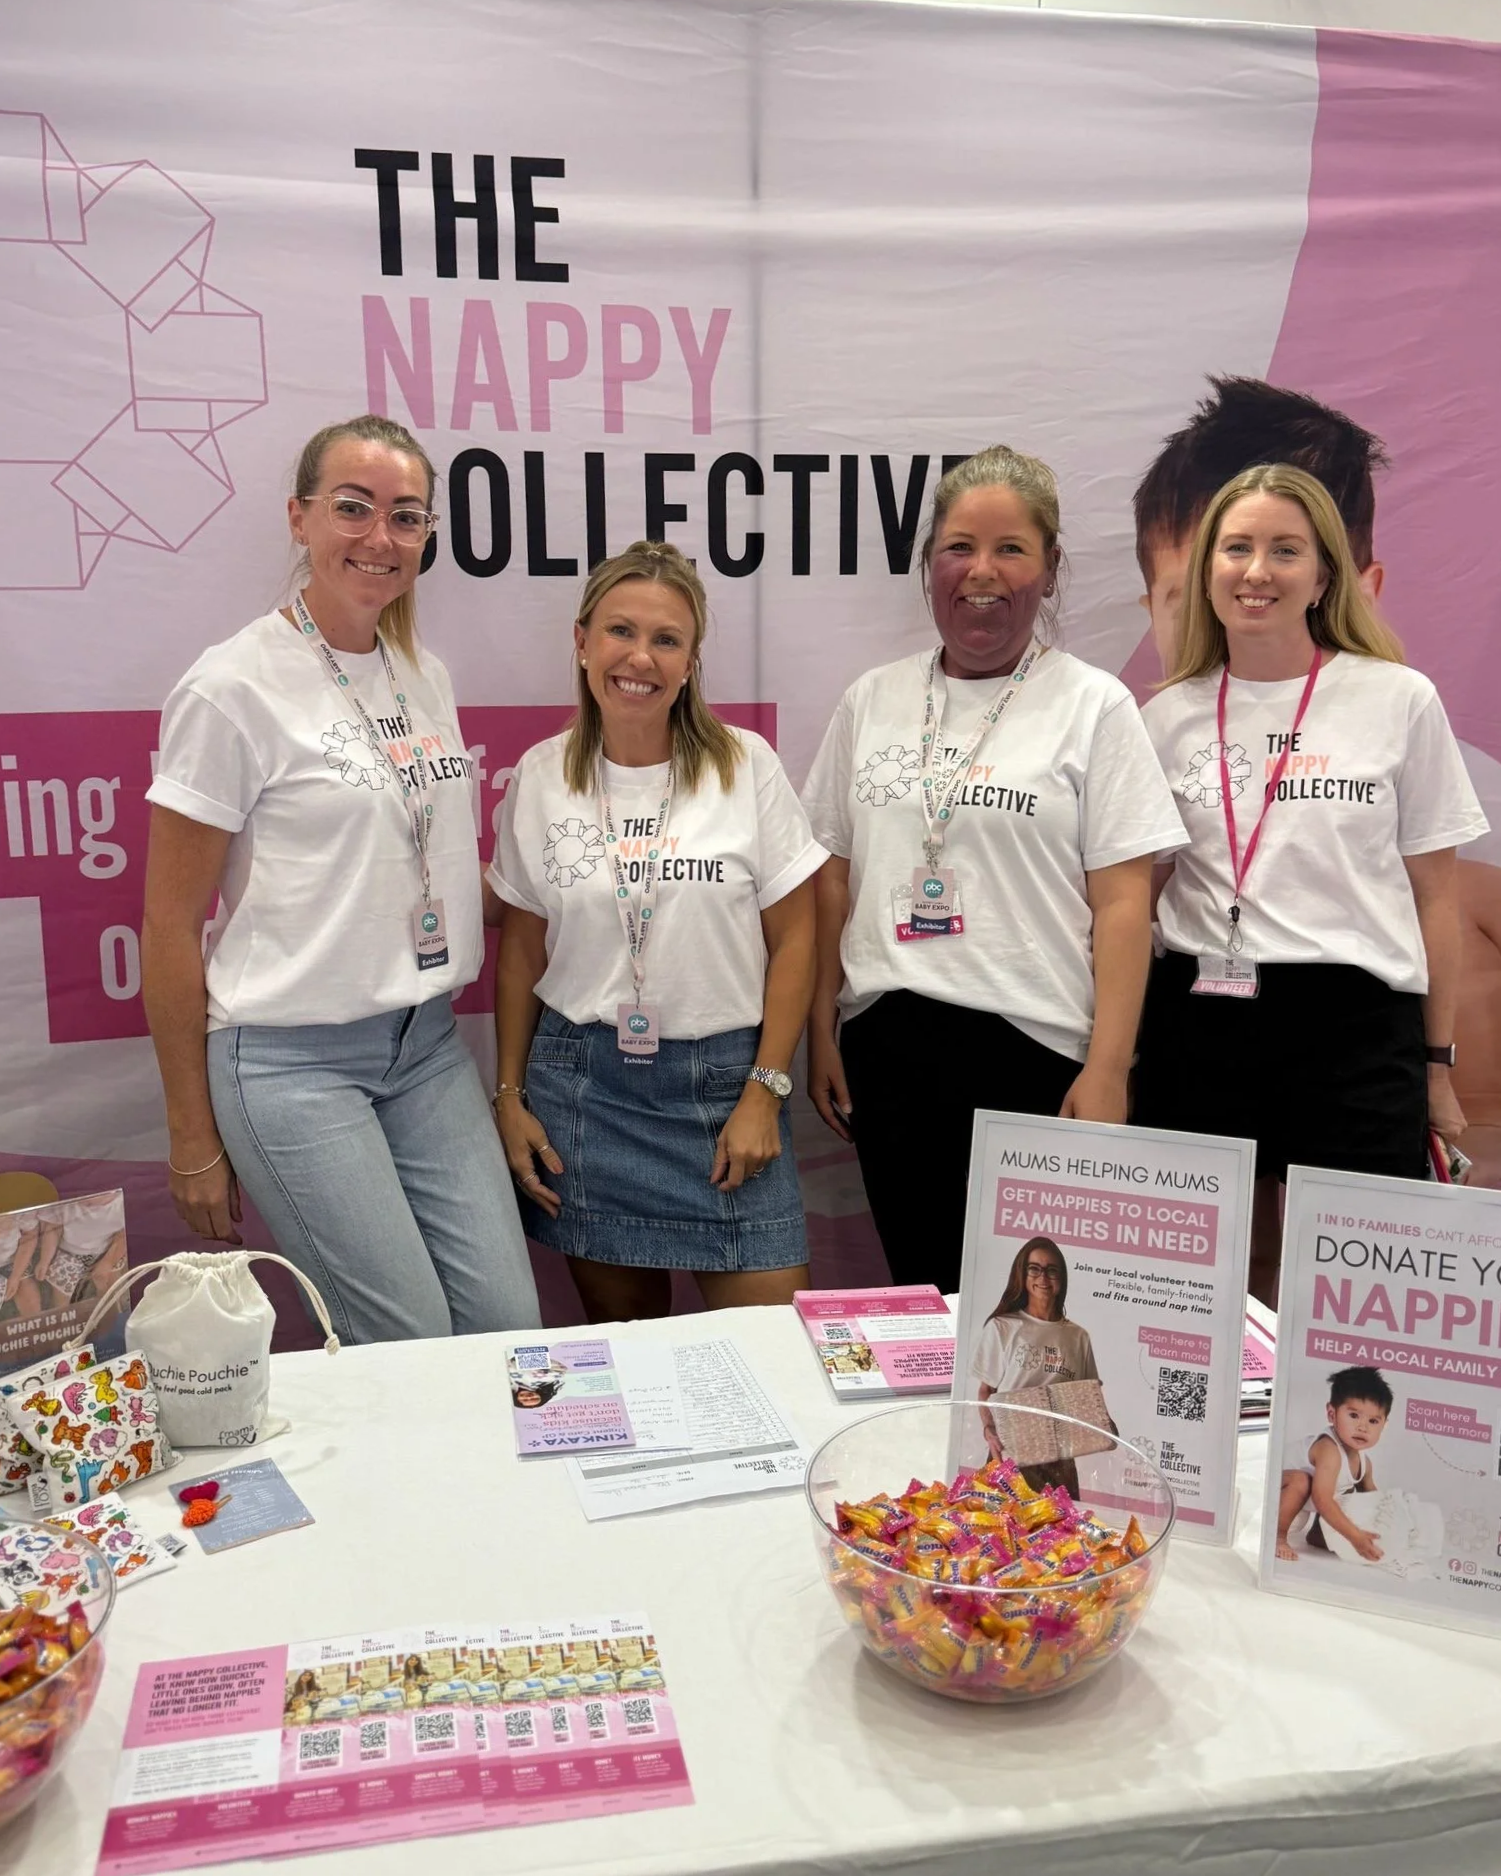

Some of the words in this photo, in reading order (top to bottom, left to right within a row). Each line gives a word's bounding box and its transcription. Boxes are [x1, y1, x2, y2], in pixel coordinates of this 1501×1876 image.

[354, 148, 569, 283] THE
[362, 295, 731, 435] NAPPY
[417, 448, 973, 577] OLLECTIV
[387, 735, 446, 765] NAPY
[1266, 733, 1302, 755] THE
[946, 793, 955, 808] BABY
[952, 779, 961, 794] EXPO
[955, 785, 1038, 817] LECTIVE
[1, 755, 127, 879] ing
[623, 818, 656, 838] THE
[619, 836, 680, 859] NAY
[623, 858, 725, 883] OECTIVE
[925, 882, 942, 893] pbc
[916, 922, 946, 931] Exhibitor
[418, 938, 431, 947] BABY
[432, 936, 445, 946] EXPO
[422, 956, 445, 967] Exhibitor
[1201, 981, 1251, 993] VOLUNTEER
[630, 1018, 647, 1029] pbc
[624, 1056, 654, 1065] Exhibitor
[1000, 1149, 1061, 1173] MUMS
[1067, 1157, 1149, 1184] HELPING
[1155, 1169, 1220, 1193] MUMS
[1002, 1187, 1036, 1203] GET
[1040, 1191, 1112, 1215] NAPPIES
[1117, 1202, 1142, 1218] TO
[1147, 1206, 1209, 1228] LOCAL
[1000, 1208, 1109, 1241] FAMILIES
[1116, 1224, 1140, 1245] IN
[1148, 1228, 1209, 1255] NEED
[1316, 1213, 1321, 1223] 1
[1325, 1213, 1338, 1226] IN
[1342, 1216, 1355, 1228] 10
[1358, 1218, 1421, 1238] FAMILIES
[1425, 1228, 1464, 1243] CAN'T
[1315, 1235, 1458, 1282] DONATE
[1472, 1256, 1501, 1286] Y
[1074, 1262, 1093, 1273] Join
[1095, 1267, 1111, 1275] our
[1114, 1267, 1138, 1279] local
[1140, 1272, 1186, 1286] volunteer
[1188, 1280, 1214, 1291] team
[1092, 1290, 1112, 1299] and
[1113, 1292, 1130, 1302] fits
[1131, 1297, 1167, 1308] around
[1169, 1303, 1188, 1313] nap
[1190, 1304, 1213, 1315] time
[1107, 1279, 1145, 1294] Flexible,
[1148, 1286, 1214, 1305] family-friendly
[1312, 1274, 1501, 1349] NAPPI
[6, 1318, 41, 1336] WHAT
[46, 1314, 57, 1327] IS
[61, 1309, 77, 1321] AN
[0, 1337, 30, 1353] CHIE
[1140, 1329, 1168, 1344] Scan
[1170, 1334, 1196, 1348] here
[1198, 1340, 1210, 1350] to
[1044, 1346, 1058, 1355] THE
[1150, 1345, 1178, 1358] learn
[1181, 1352, 1209, 1363] more
[1314, 1338, 1352, 1355] HELP
[1356, 1345, 1368, 1358] A
[1373, 1347, 1429, 1368] LOCAL
[1434, 1357, 1498, 1379] FAMILY
[164, 1385, 177, 1393] feel
[178, 1387, 195, 1395] good
[196, 1386, 212, 1395] cold
[214, 1384, 233, 1394] pack
[546, 1404, 600, 1412] schedule
[567, 1410, 586, 1418] get
[588, 1409, 620, 1417] don't
[1408, 1402, 1439, 1418] Scan
[1443, 1408, 1470, 1423] here
[224, 1425, 254, 1437] mama
[572, 1416, 622, 1425] Because
[1408, 1417, 1420, 1428] to
[1423, 1418, 1455, 1434] learn
[1458, 1427, 1490, 1440] more
[544, 1433, 628, 1446] KINKAYA
[1162, 1441, 1175, 1451] THE
[733, 1459, 773, 1469] COLLECTIVE
[1160, 1451, 1184, 1462] NAPPY
[1160, 1460, 1202, 1475] COLLECTIVE
[917, 1543, 944, 1552] ntos
[153, 1682, 167, 1690] WE
[169, 1680, 196, 1689] KNOW
[198, 1676, 220, 1685] HOW
[220, 1671, 256, 1682] QUICKLY
[155, 1674, 166, 1682] AT
[167, 1671, 184, 1681] THE
[185, 1667, 215, 1678] NAPPY
[216, 1661, 269, 1674] COLLECTIVE,
[150, 1697, 187, 1709] LEAVING
[188, 1693, 221, 1703] BEHIND
[224, 1687, 261, 1699] NAPPIES
[151, 1690, 181, 1700] LITTLE
[182, 1686, 206, 1696] ONES
[237, 1678, 266, 1688] OFTEN
[148, 1708, 170, 1718] THAT
[171, 1706, 185, 1715] NO
[187, 1703, 222, 1713] LONGER
